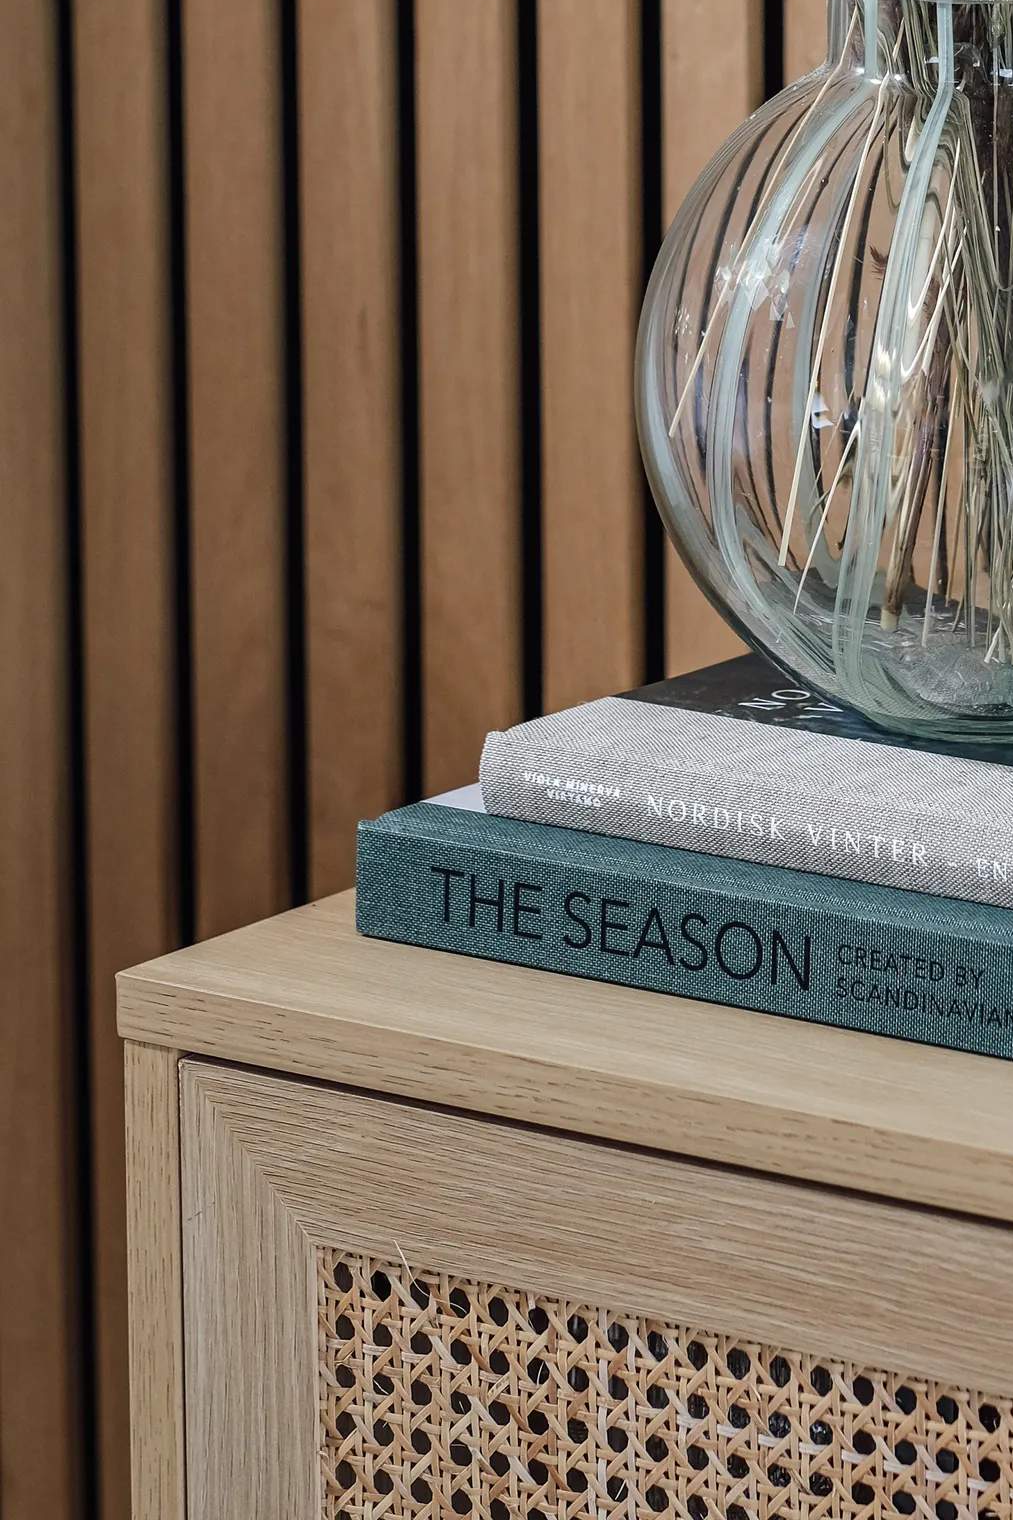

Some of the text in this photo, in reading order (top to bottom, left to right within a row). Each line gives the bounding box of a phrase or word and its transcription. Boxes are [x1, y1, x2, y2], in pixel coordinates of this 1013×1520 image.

[523, 771, 621, 799] VIOLA MINERVA
[646, 794, 785, 841] NORDISK
[807, 824, 928, 867] VINTER
[977, 859, 1008, 881] EN
[430, 867, 811, 991] THE SEASON
[838, 944, 985, 988] CREATED BY
